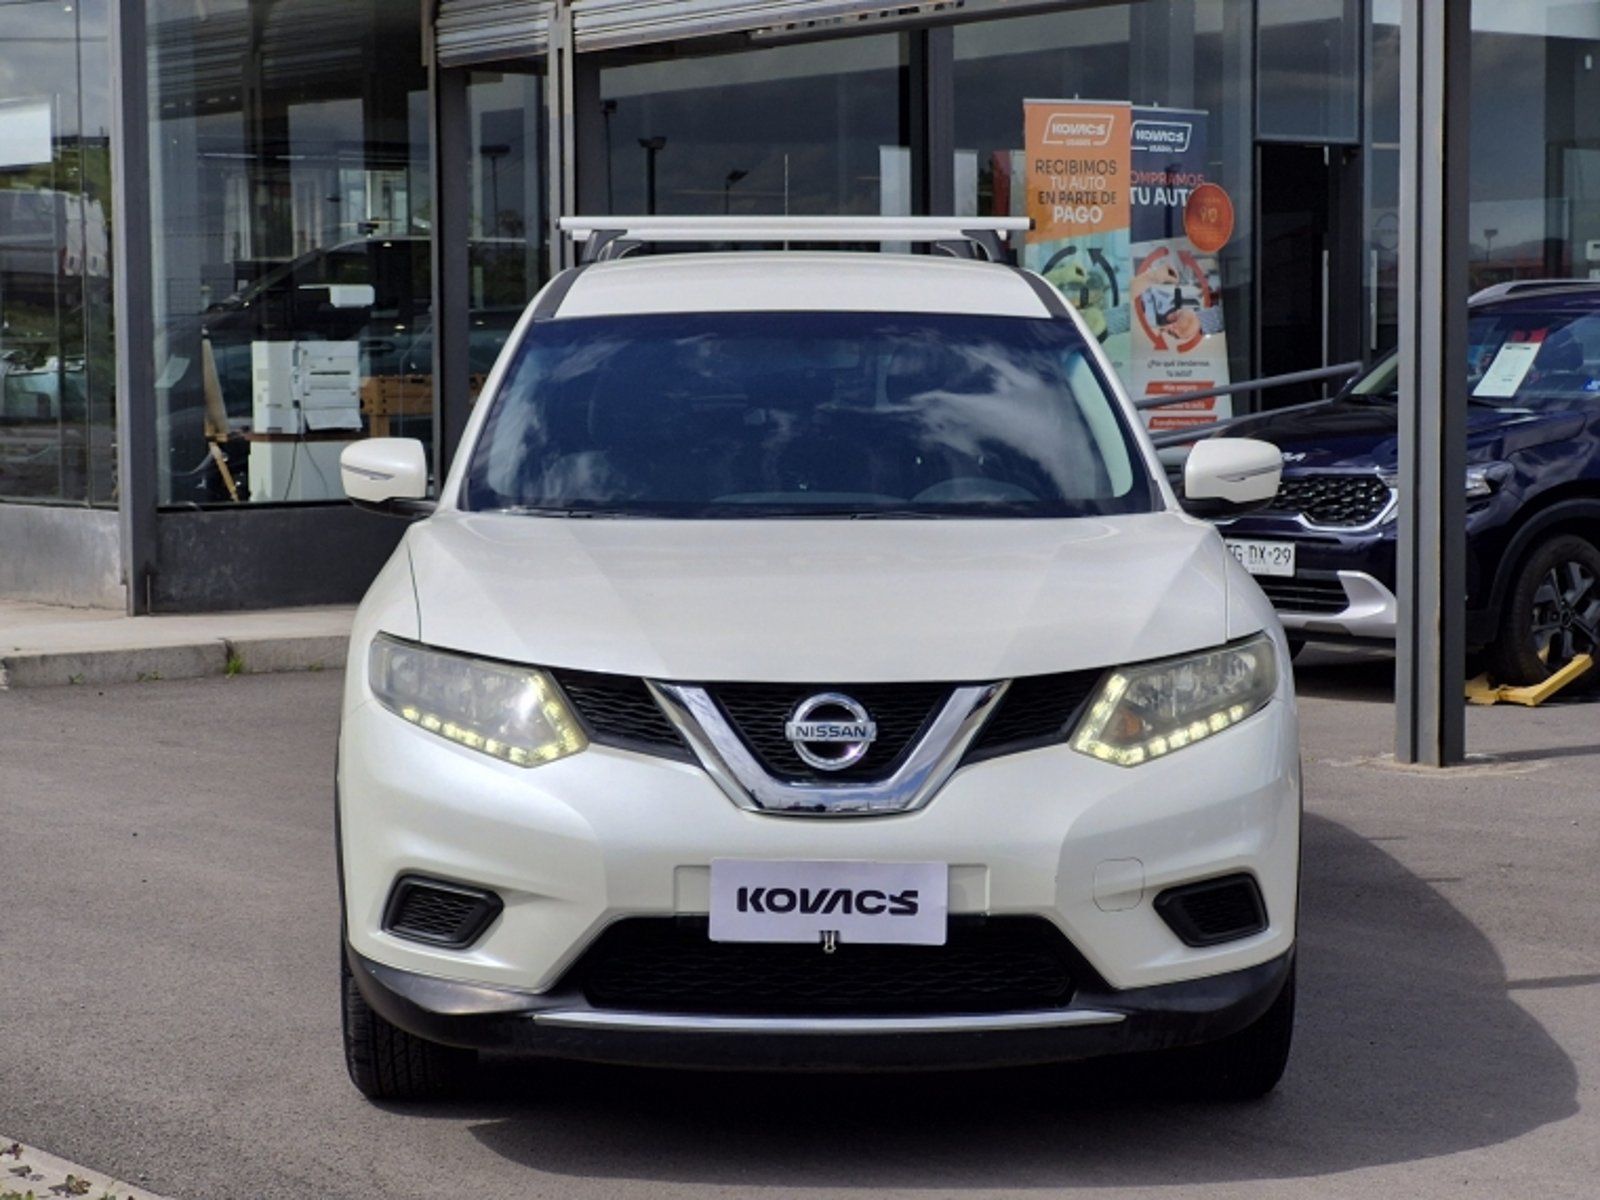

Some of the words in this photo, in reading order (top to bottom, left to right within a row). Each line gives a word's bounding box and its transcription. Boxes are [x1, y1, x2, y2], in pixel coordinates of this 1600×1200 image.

[1035, 159, 1117, 175] RECIBIMOS
[1050, 175, 1066, 190] TU
[1069, 175, 1106, 190] AUTO
[1131, 170, 1205, 187] OMPRAMOS
[1038, 191, 1056, 205] EN
[1059, 191, 1097, 205] PARTE
[1101, 191, 1117, 205] DE
[1130, 186, 1151, 205] TU
[1153, 187, 1193, 207] AUT
[1052, 205, 1104, 224] PAGO
[795, 724, 868, 738] NISSAN
[737, 887, 919, 916] KOVACS
